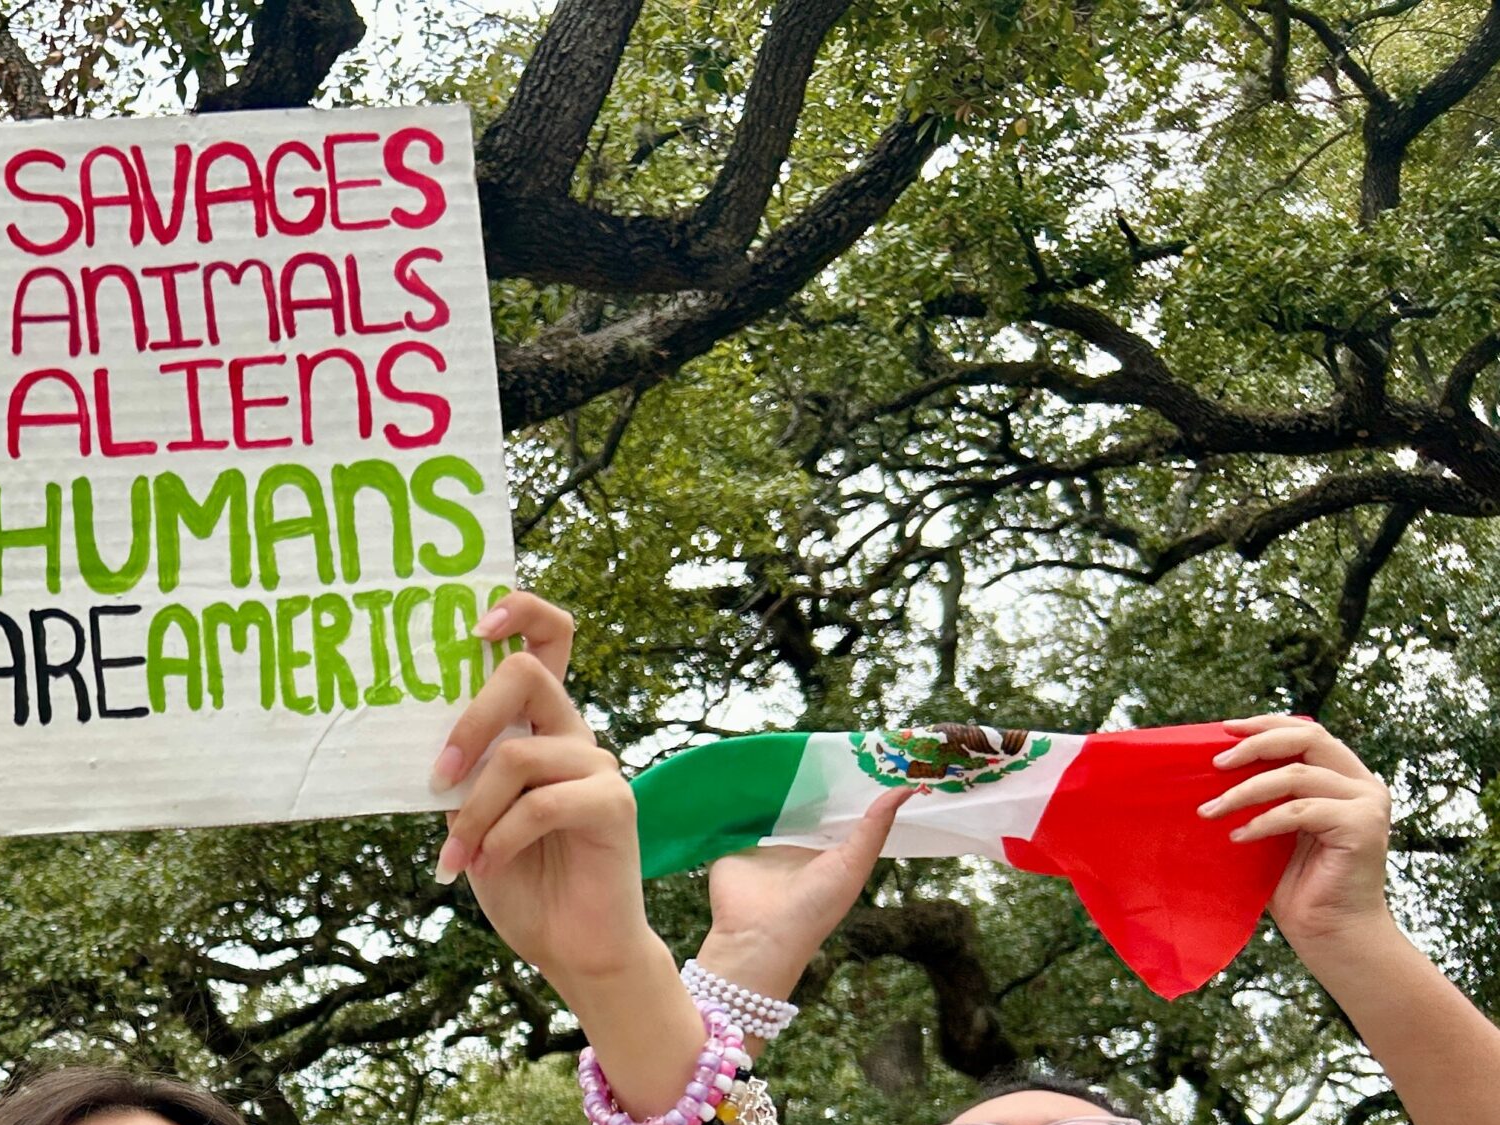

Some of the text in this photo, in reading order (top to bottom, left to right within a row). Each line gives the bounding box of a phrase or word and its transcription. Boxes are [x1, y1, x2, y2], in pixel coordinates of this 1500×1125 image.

[4, 126, 447, 256] SAVAGES
[11, 245, 451, 358] ANIMALS
[6, 339, 452, 460] ALIENS
